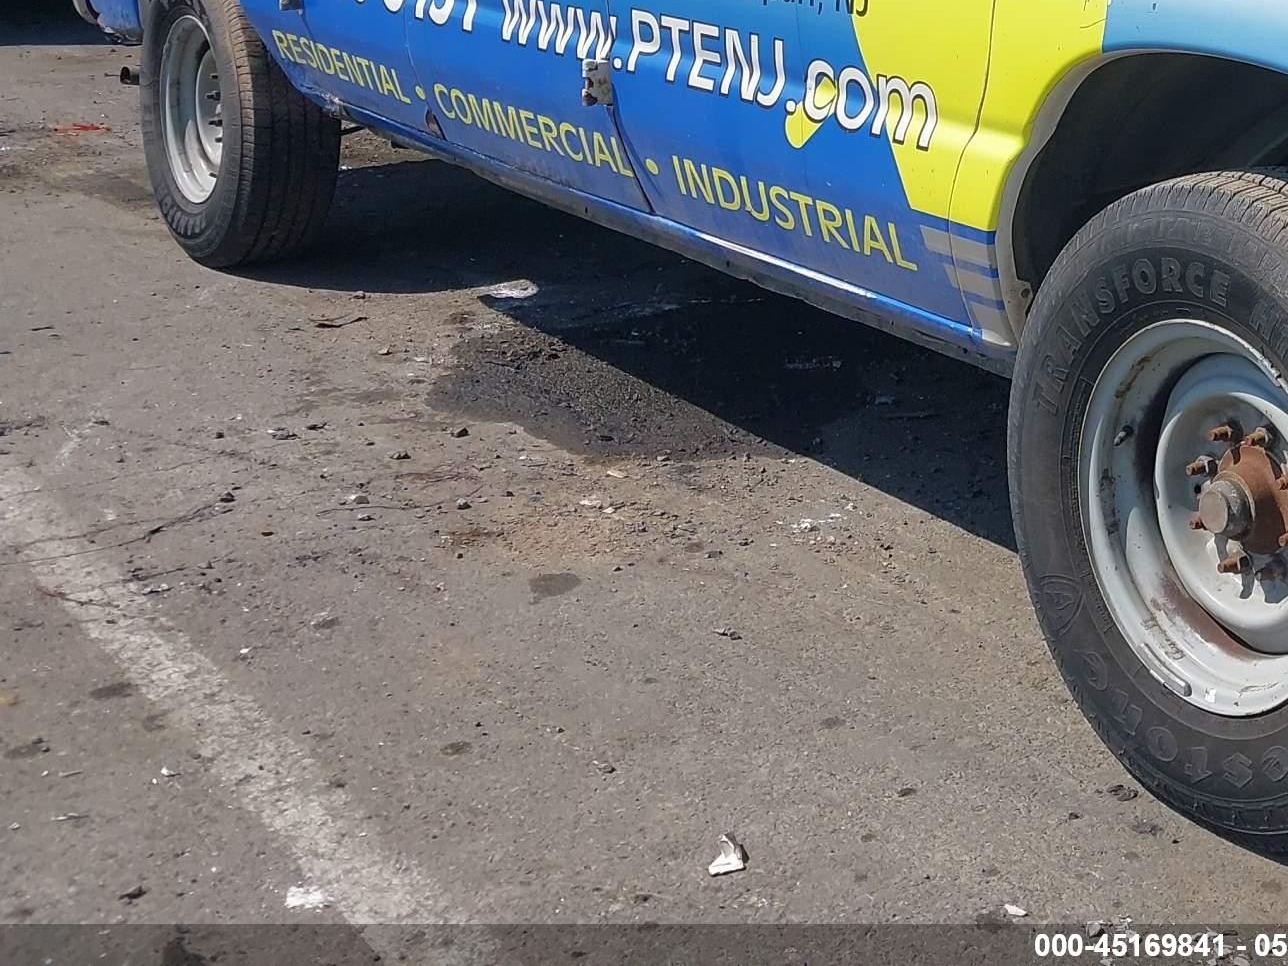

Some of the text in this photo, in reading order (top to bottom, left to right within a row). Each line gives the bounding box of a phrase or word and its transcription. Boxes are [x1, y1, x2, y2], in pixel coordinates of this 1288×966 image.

[272, 30, 918, 271] RESIDENTIAL COMMERCIAL INDUSTRIAL
[1034, 256, 1233, 418] TRANSFORCE
